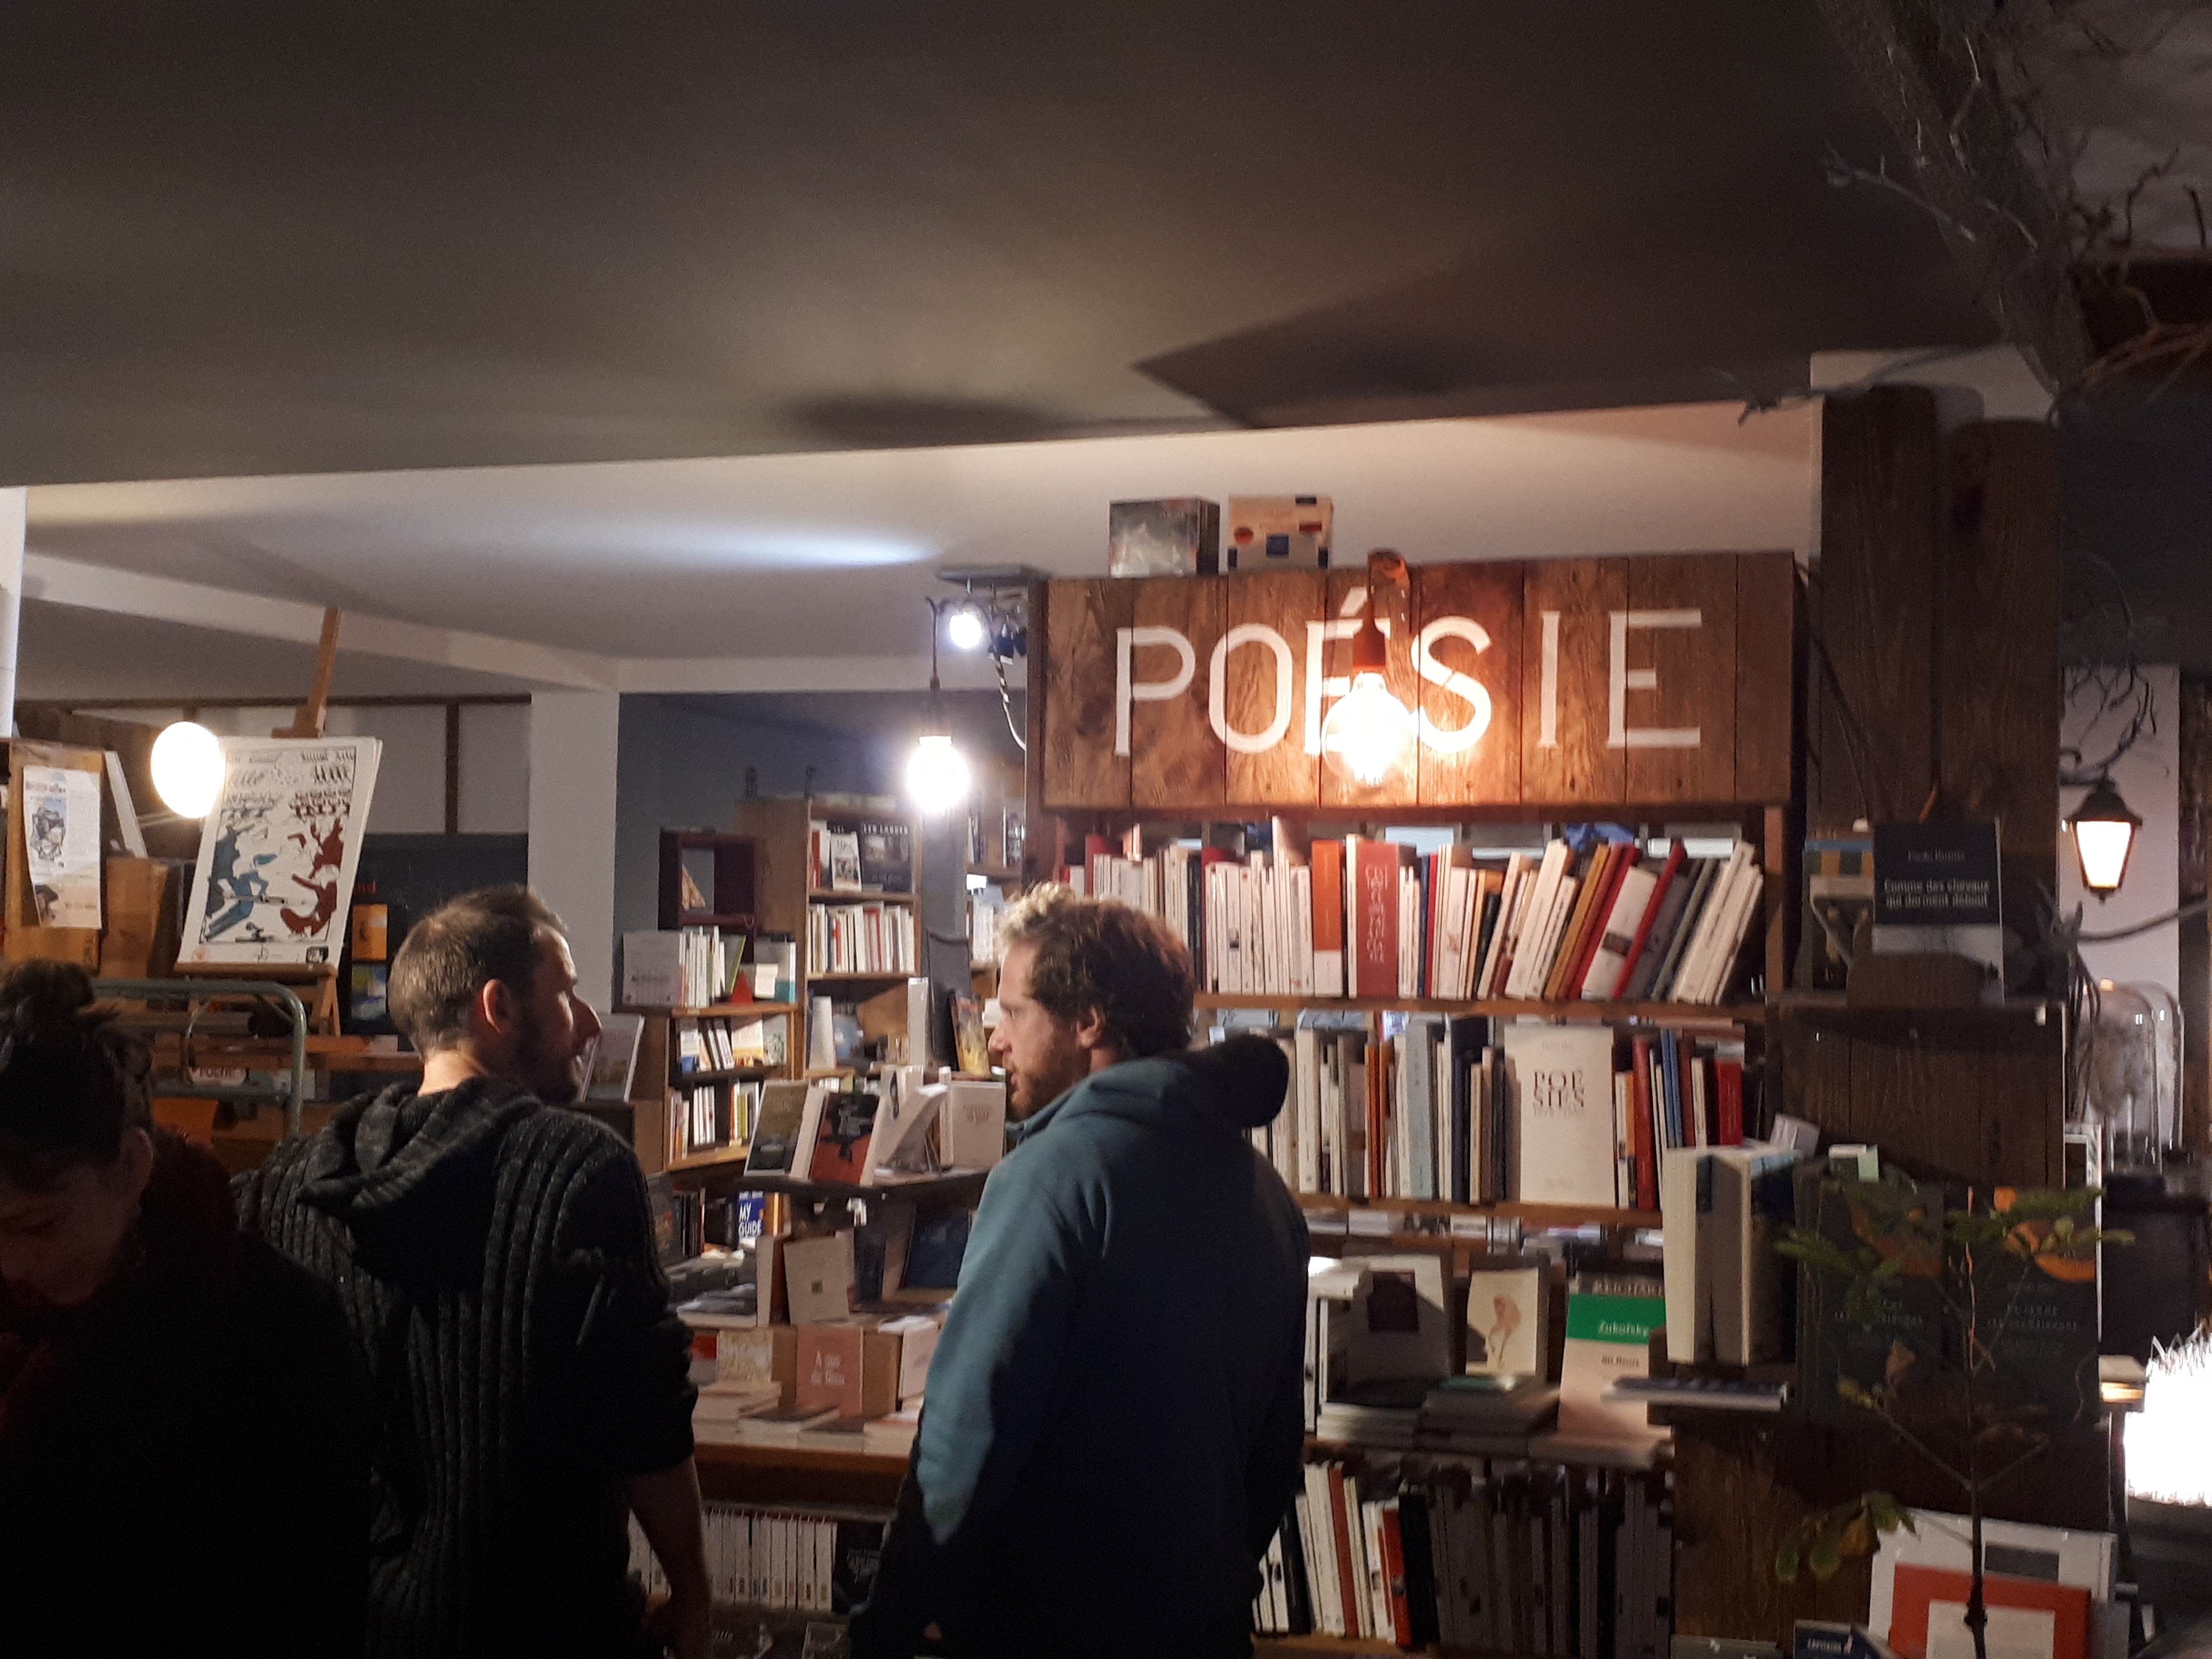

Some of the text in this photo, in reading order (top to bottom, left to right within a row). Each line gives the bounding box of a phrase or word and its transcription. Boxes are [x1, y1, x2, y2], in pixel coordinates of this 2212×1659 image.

[739, 1202, 751, 1222] MY
[738, 1219, 762, 1238] GUIDE
[1598, 1321, 1650, 1337] Zukofsky
